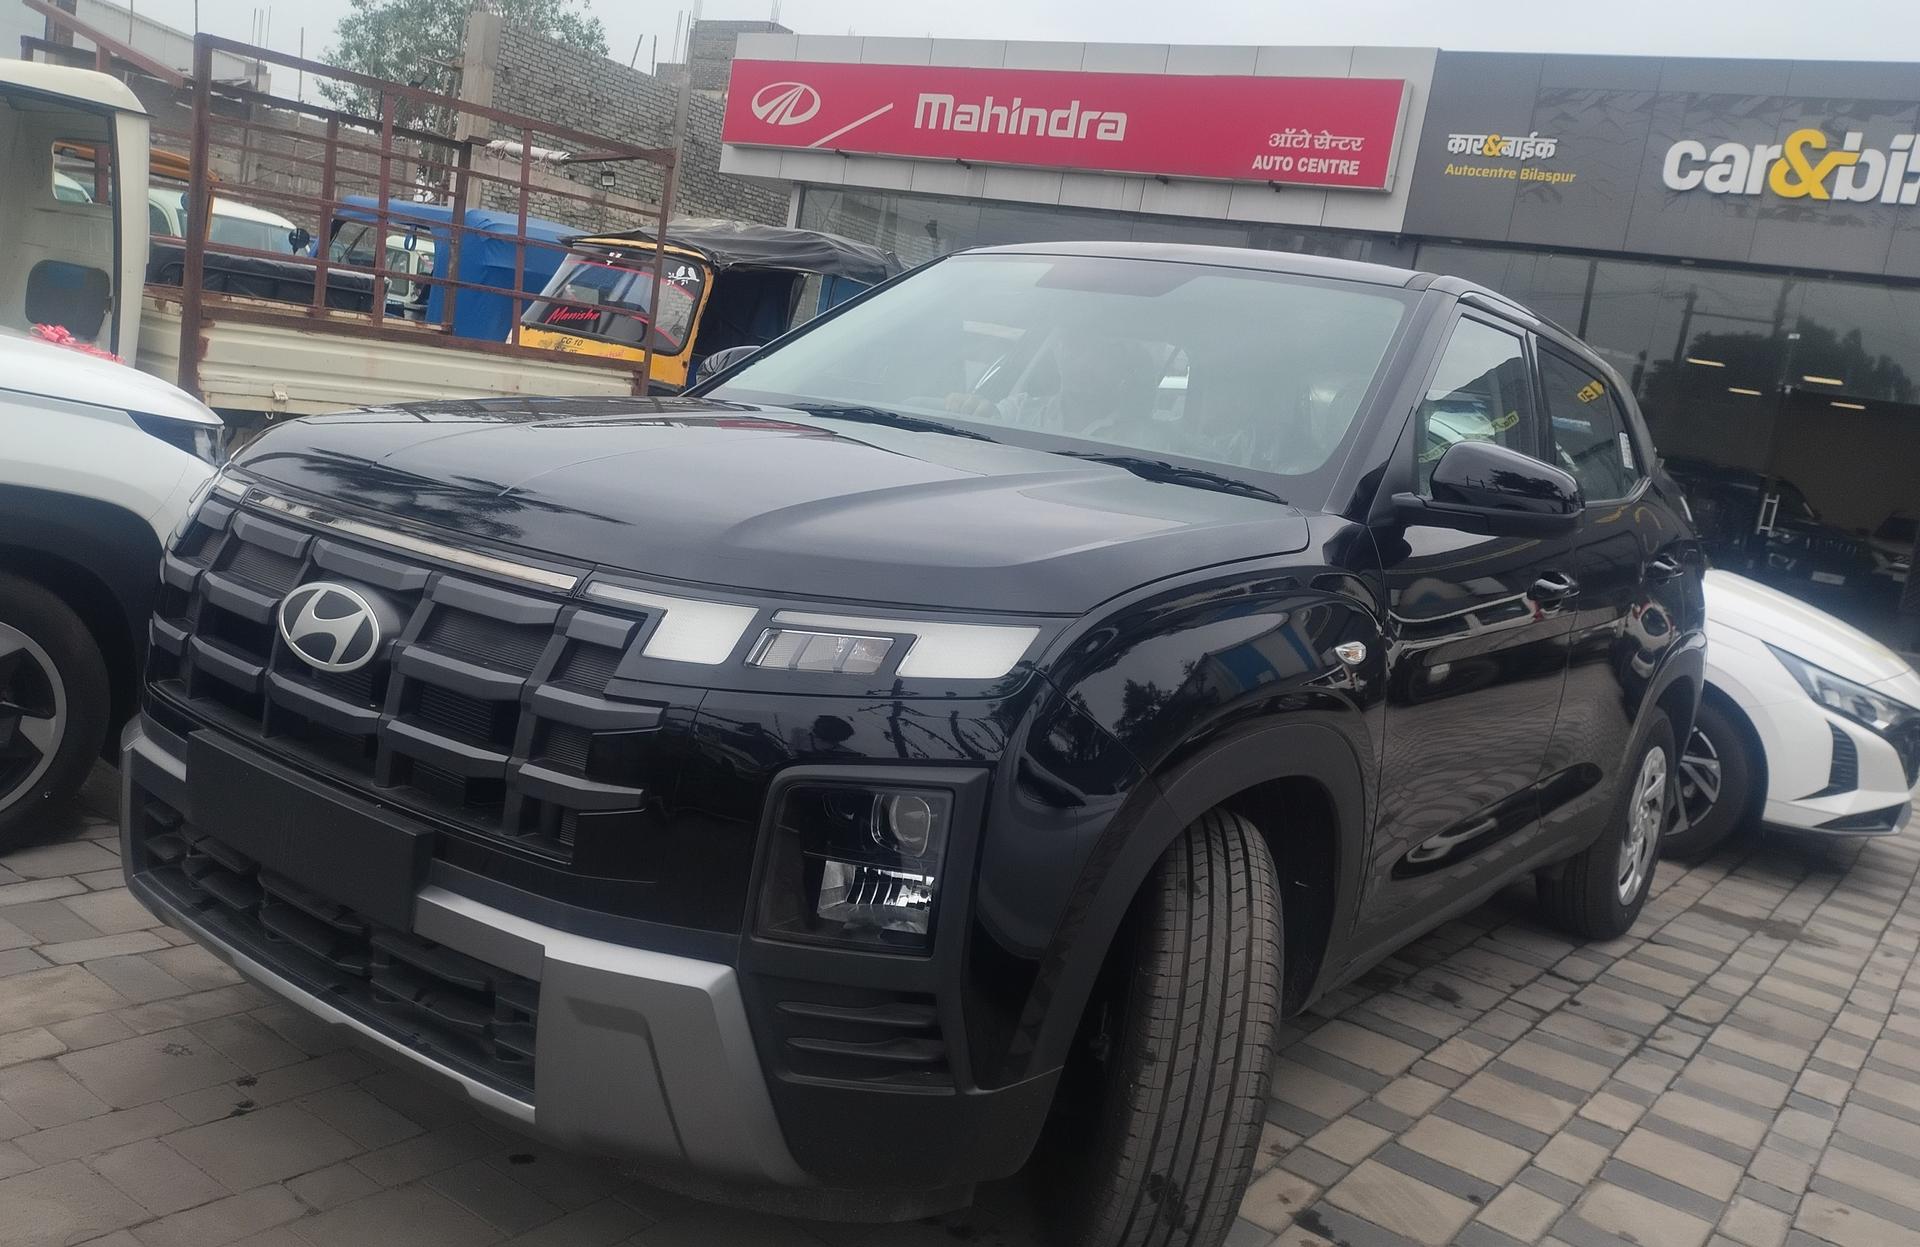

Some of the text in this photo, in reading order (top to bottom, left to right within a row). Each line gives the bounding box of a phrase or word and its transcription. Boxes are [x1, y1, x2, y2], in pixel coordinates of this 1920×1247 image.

[914, 93, 1128, 142] Mahindra
[1268, 128, 1365, 152] ऑटो सेन्टर
[1252, 155, 1360, 175] AUTO CENTRE
[1444, 163, 1577, 184] Autocentre Bilaspur
[544, 306, 600, 325] Manisha
